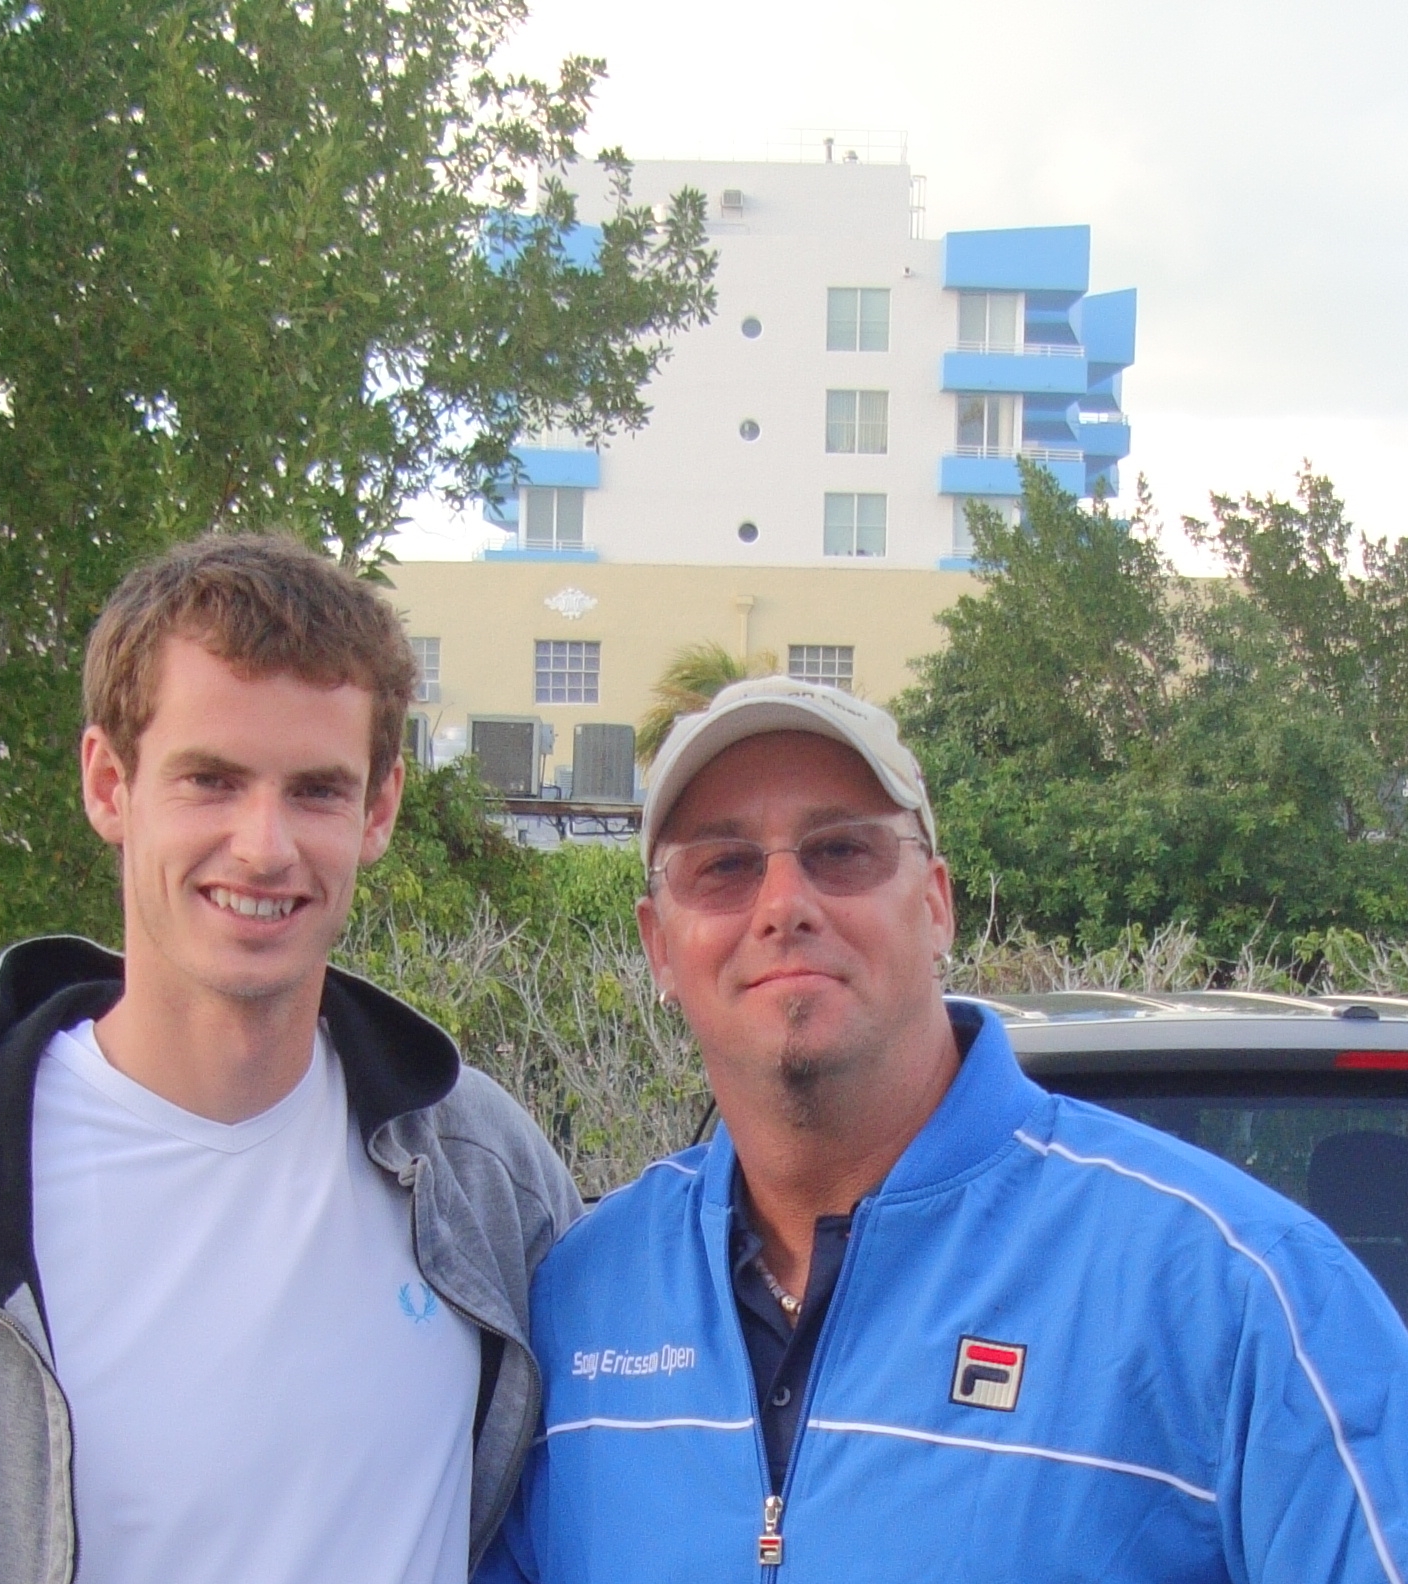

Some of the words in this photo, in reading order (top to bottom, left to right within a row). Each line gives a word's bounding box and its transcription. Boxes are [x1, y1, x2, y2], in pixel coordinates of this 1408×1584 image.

[572, 1350, 600, 1381] Sony
[600, 1349, 659, 1376] Ericsson
[660, 1344, 695, 1377] Open
